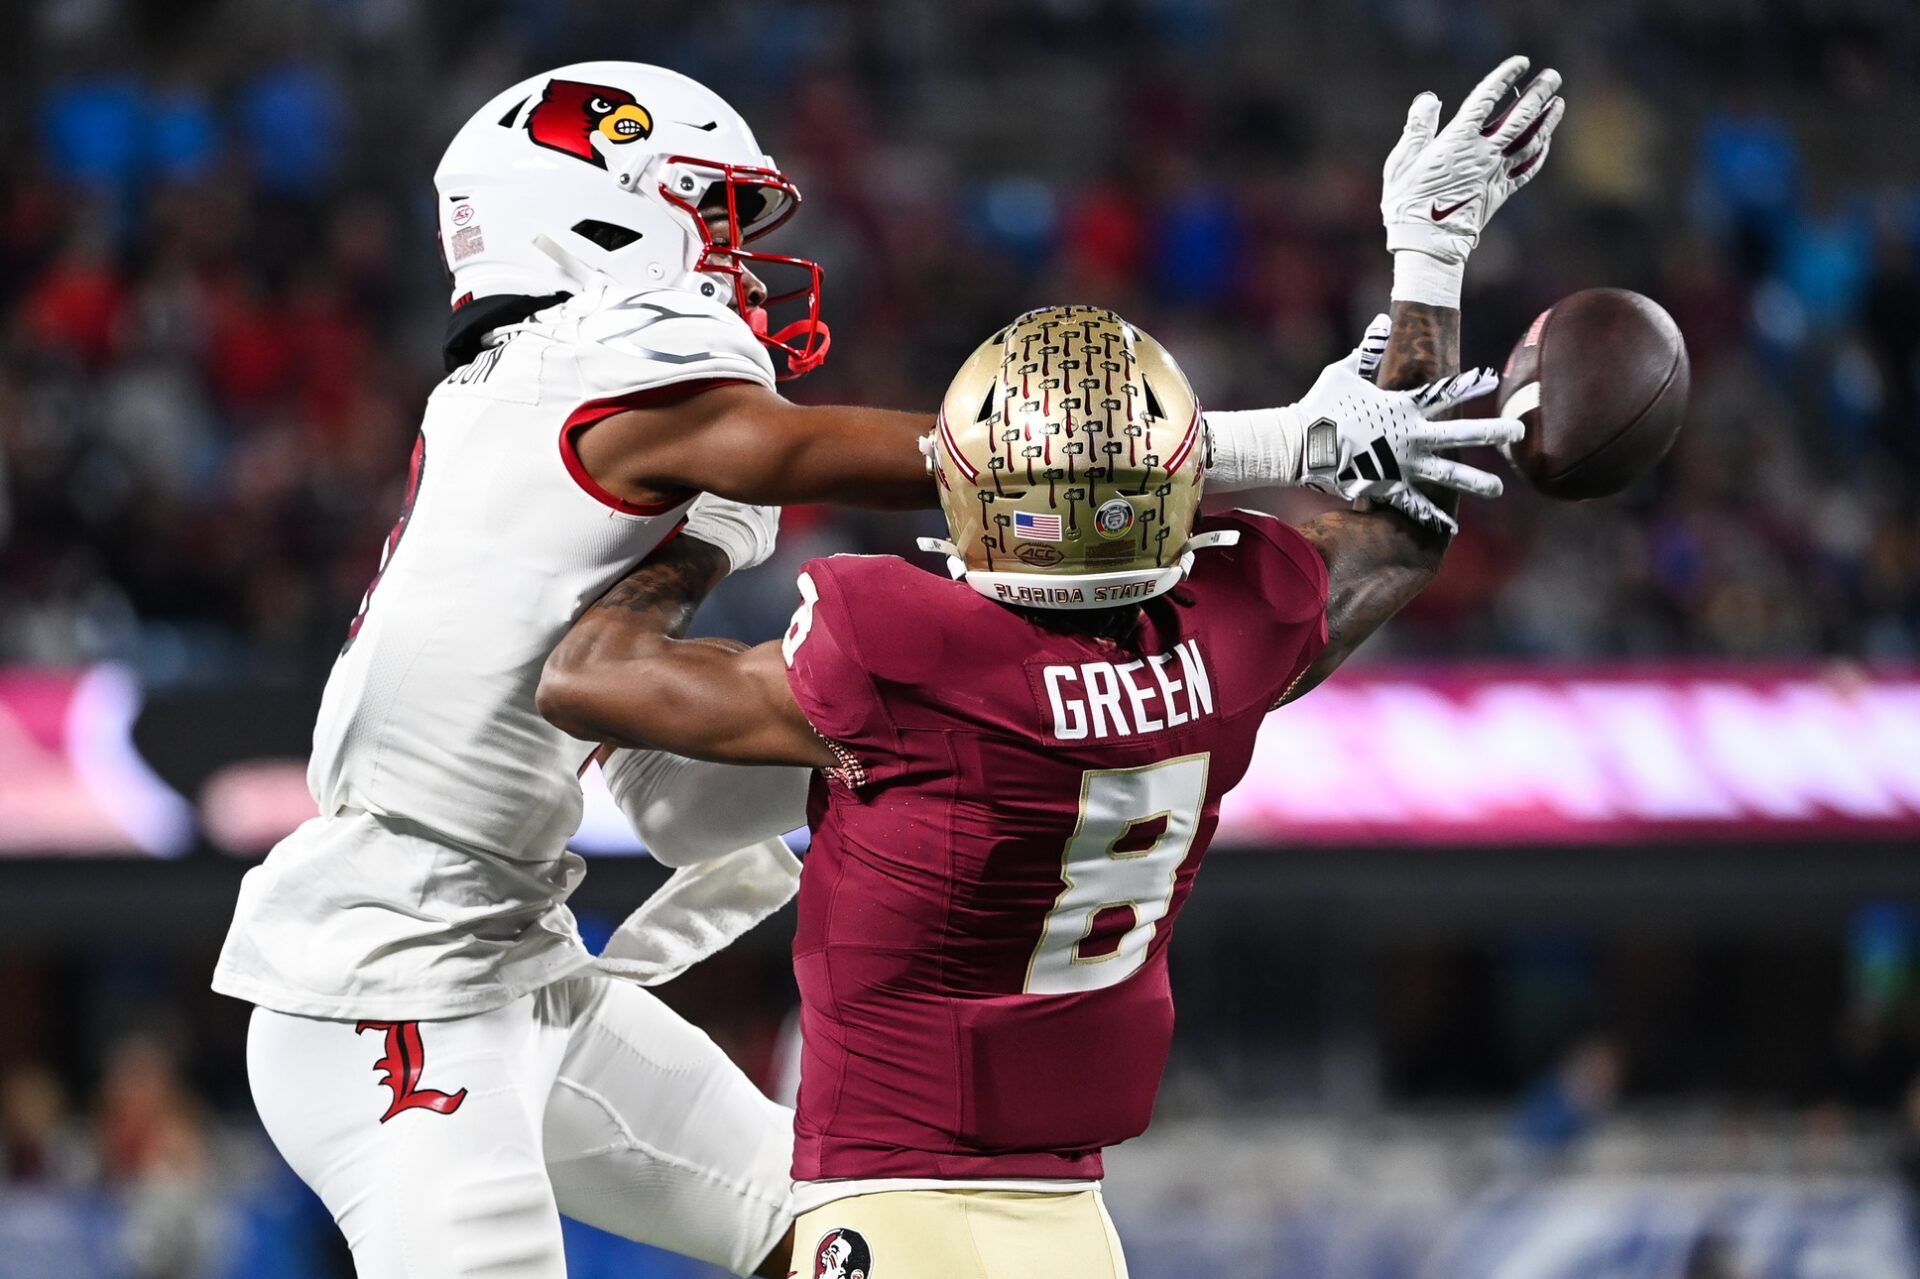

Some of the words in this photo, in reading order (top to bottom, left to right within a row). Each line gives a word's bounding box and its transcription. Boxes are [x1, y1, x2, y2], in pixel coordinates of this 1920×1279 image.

[994, 583, 1084, 604] FLORIDA
[1094, 580, 1157, 602] STATE
[1020, 548, 1056, 560] ACC
[1043, 639, 1213, 740] GREEN
[1023, 752, 1210, 994] 8
[355, 1020, 468, 1124] L
